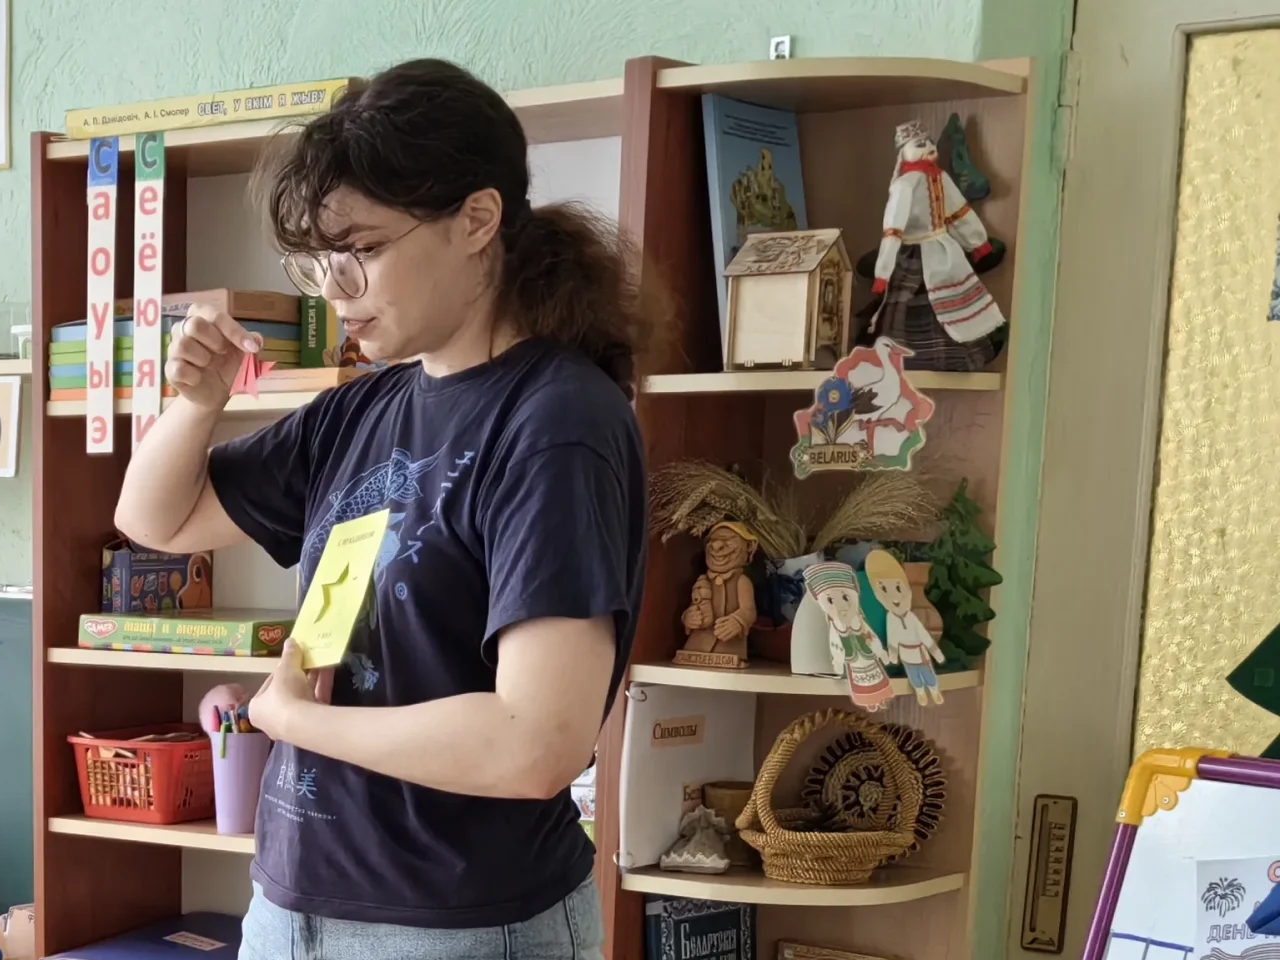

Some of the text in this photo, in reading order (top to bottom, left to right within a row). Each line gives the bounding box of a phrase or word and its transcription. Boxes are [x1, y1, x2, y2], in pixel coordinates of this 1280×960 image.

[197, 101, 228, 117] СВЕТ,
[245, 95, 273, 111] ЯКІМ
[278, 94, 287, 108] Я
[291, 89, 326, 106] ЖЫВУ
[138, 232, 158, 272] ё
[136, 298, 159, 328] ю
[89, 360, 110, 389] ы
[136, 359, 155, 388] я
[91, 416, 108, 445] э
[809, 450, 858, 465] BELARUS
[653, 722, 698, 740] Символы
